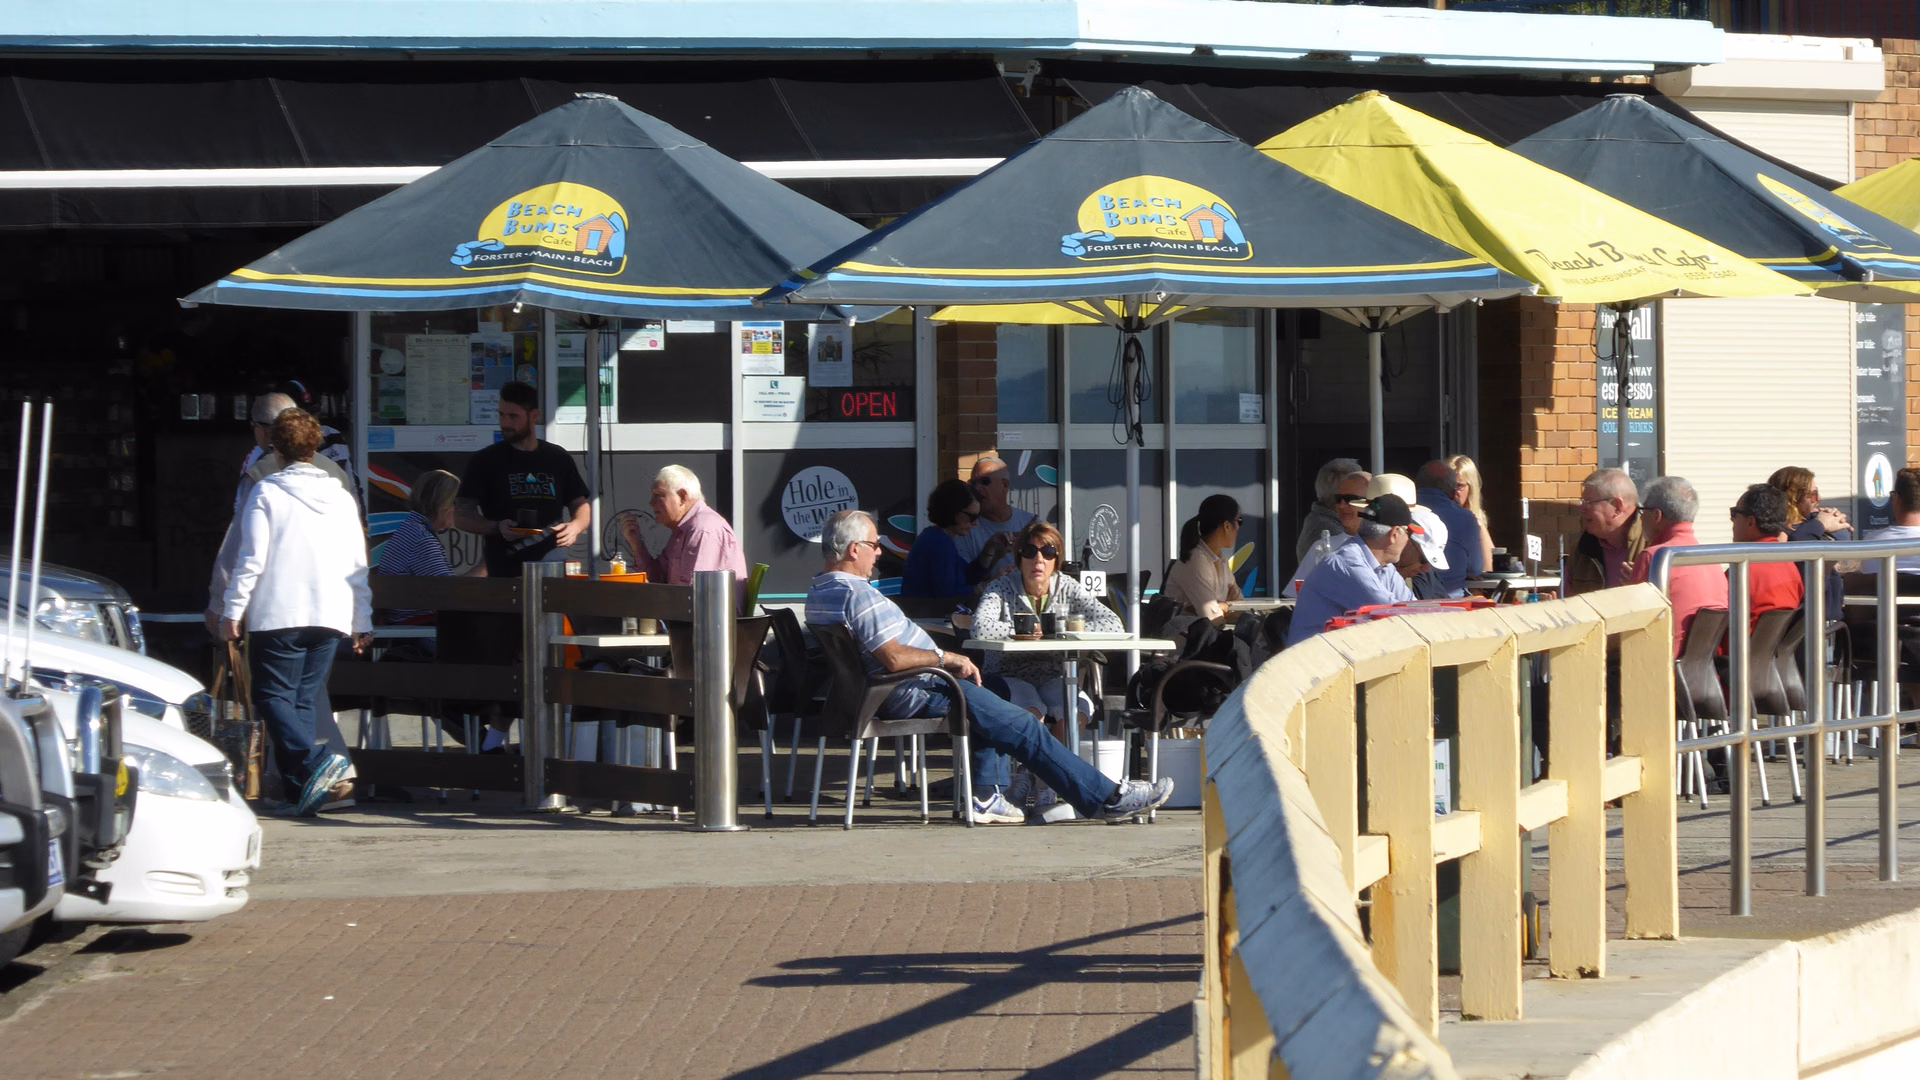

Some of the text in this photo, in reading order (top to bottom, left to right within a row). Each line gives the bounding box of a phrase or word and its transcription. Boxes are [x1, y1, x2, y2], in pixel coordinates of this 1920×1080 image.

[506, 201, 583, 219] BEACH
[1098, 194, 1182, 211] BEACH
[502, 219, 569, 237] BUMS
[1103, 211, 1177, 228] BUMS
[1155, 226, 1187, 237] Cafe
[542, 235, 573, 247] Cafe
[1652, 247, 1719, 271] Cafe
[1601, 311, 1616, 328] the
[1601, 366, 1653, 376] TAKAWAY
[1601, 381, 1653, 403] espesso
[841, 391, 897, 417] OPEN
[1602, 407, 1654, 419] ICE REAM
[1602, 421, 1654, 434] COL RINKS
[510, 483, 551, 496] BUMS
[789, 474, 849, 505] Hole in
[792, 511, 811, 526] the
[449, 527, 484, 569] BU
[1084, 575, 1102, 592] 92
